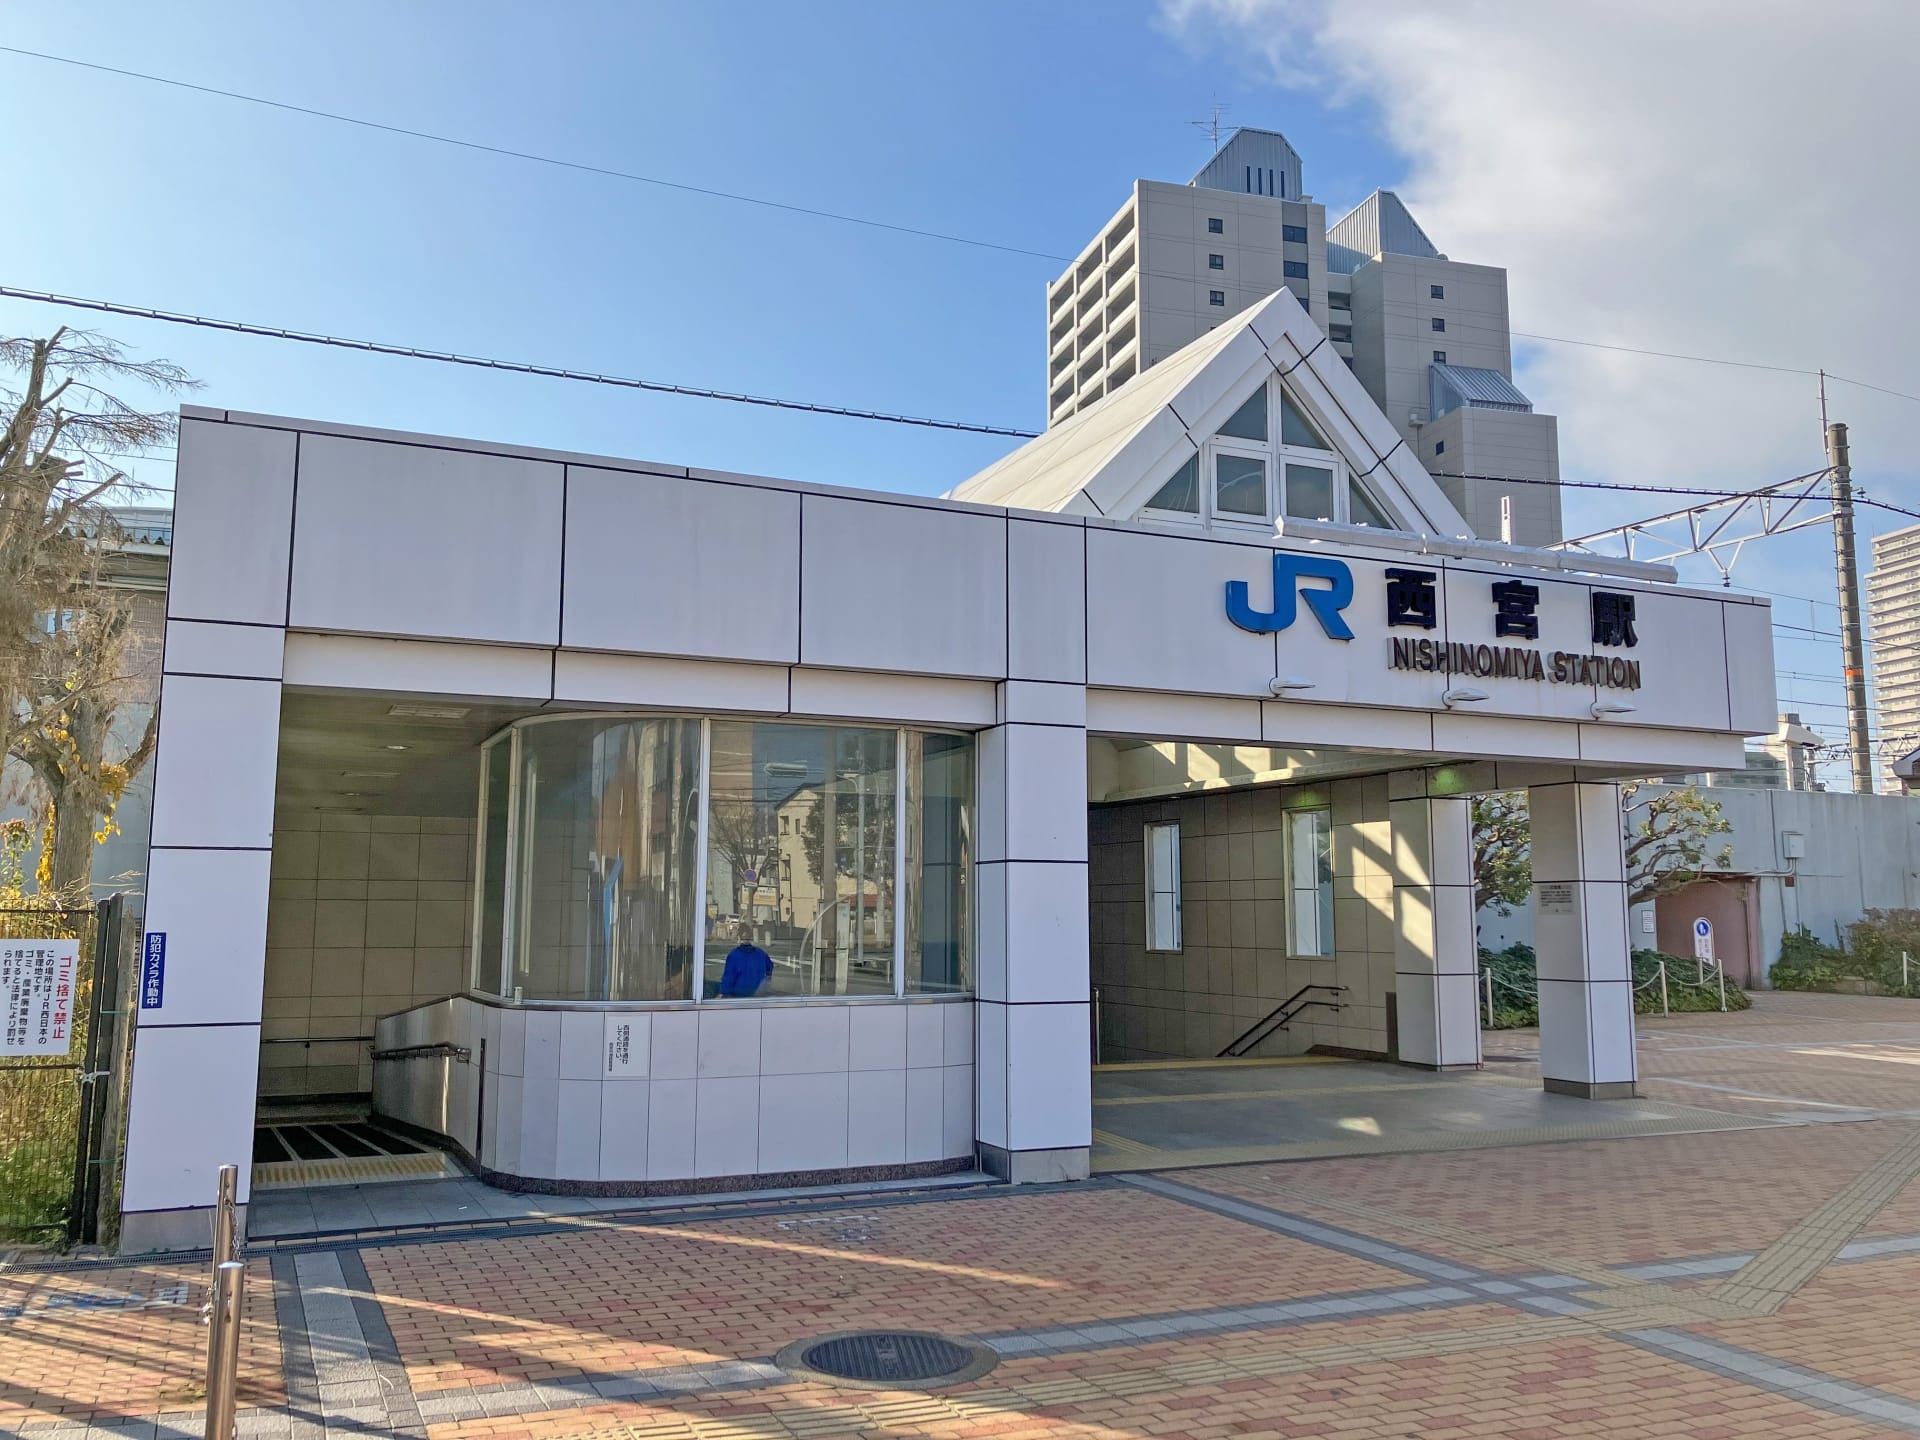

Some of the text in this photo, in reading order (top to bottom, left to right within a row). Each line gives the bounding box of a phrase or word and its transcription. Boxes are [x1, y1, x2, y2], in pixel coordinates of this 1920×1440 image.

[1225, 554, 1355, 640] JR
[1385, 568, 1638, 647] 西宮駅
[1388, 637, 1641, 691] NISHINOMIYA STATION
[52, 956, 72, 1039] ゴミ捨て禁止
[146, 934, 162, 1006] 防犯カメラ作動中
